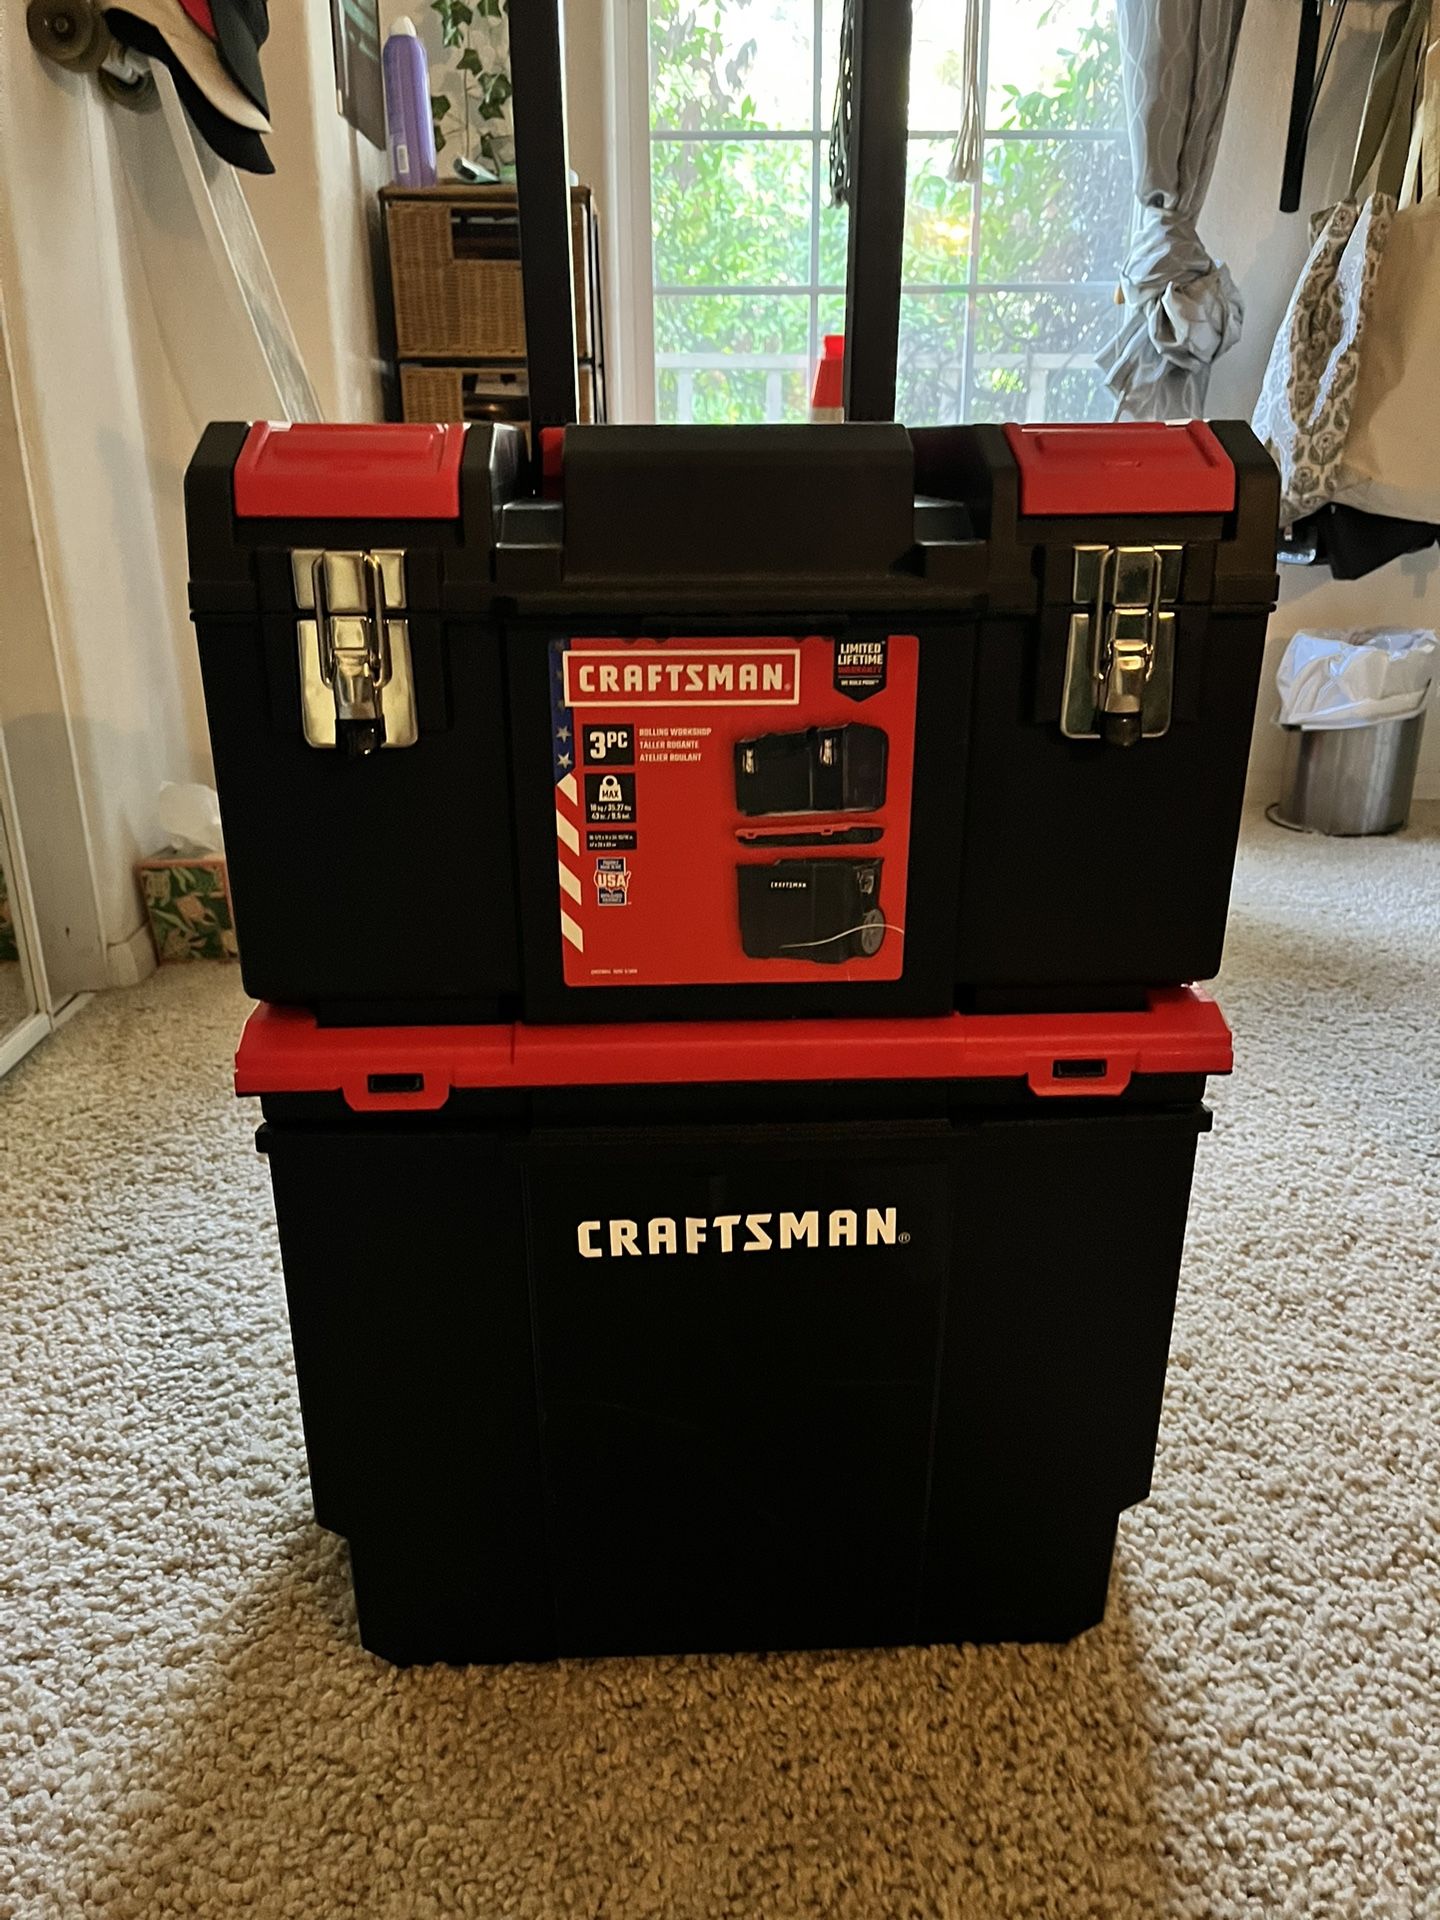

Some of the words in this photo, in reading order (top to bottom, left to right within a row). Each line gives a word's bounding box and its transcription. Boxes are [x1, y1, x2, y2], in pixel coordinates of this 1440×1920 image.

[840, 643, 882, 655] LIMITED
[837, 654, 884, 666] LIFETIME
[579, 663, 783, 693] CRAFTSMAN
[639, 728, 669, 737] ROLLING
[670, 727, 712, 737] WORKSHOP
[640, 740, 666, 750] TALLER
[640, 753, 669, 763] ATELIER
[669, 753, 702, 763] ROULANT
[602, 790, 619, 799] MAX
[598, 873, 626, 888] USA
